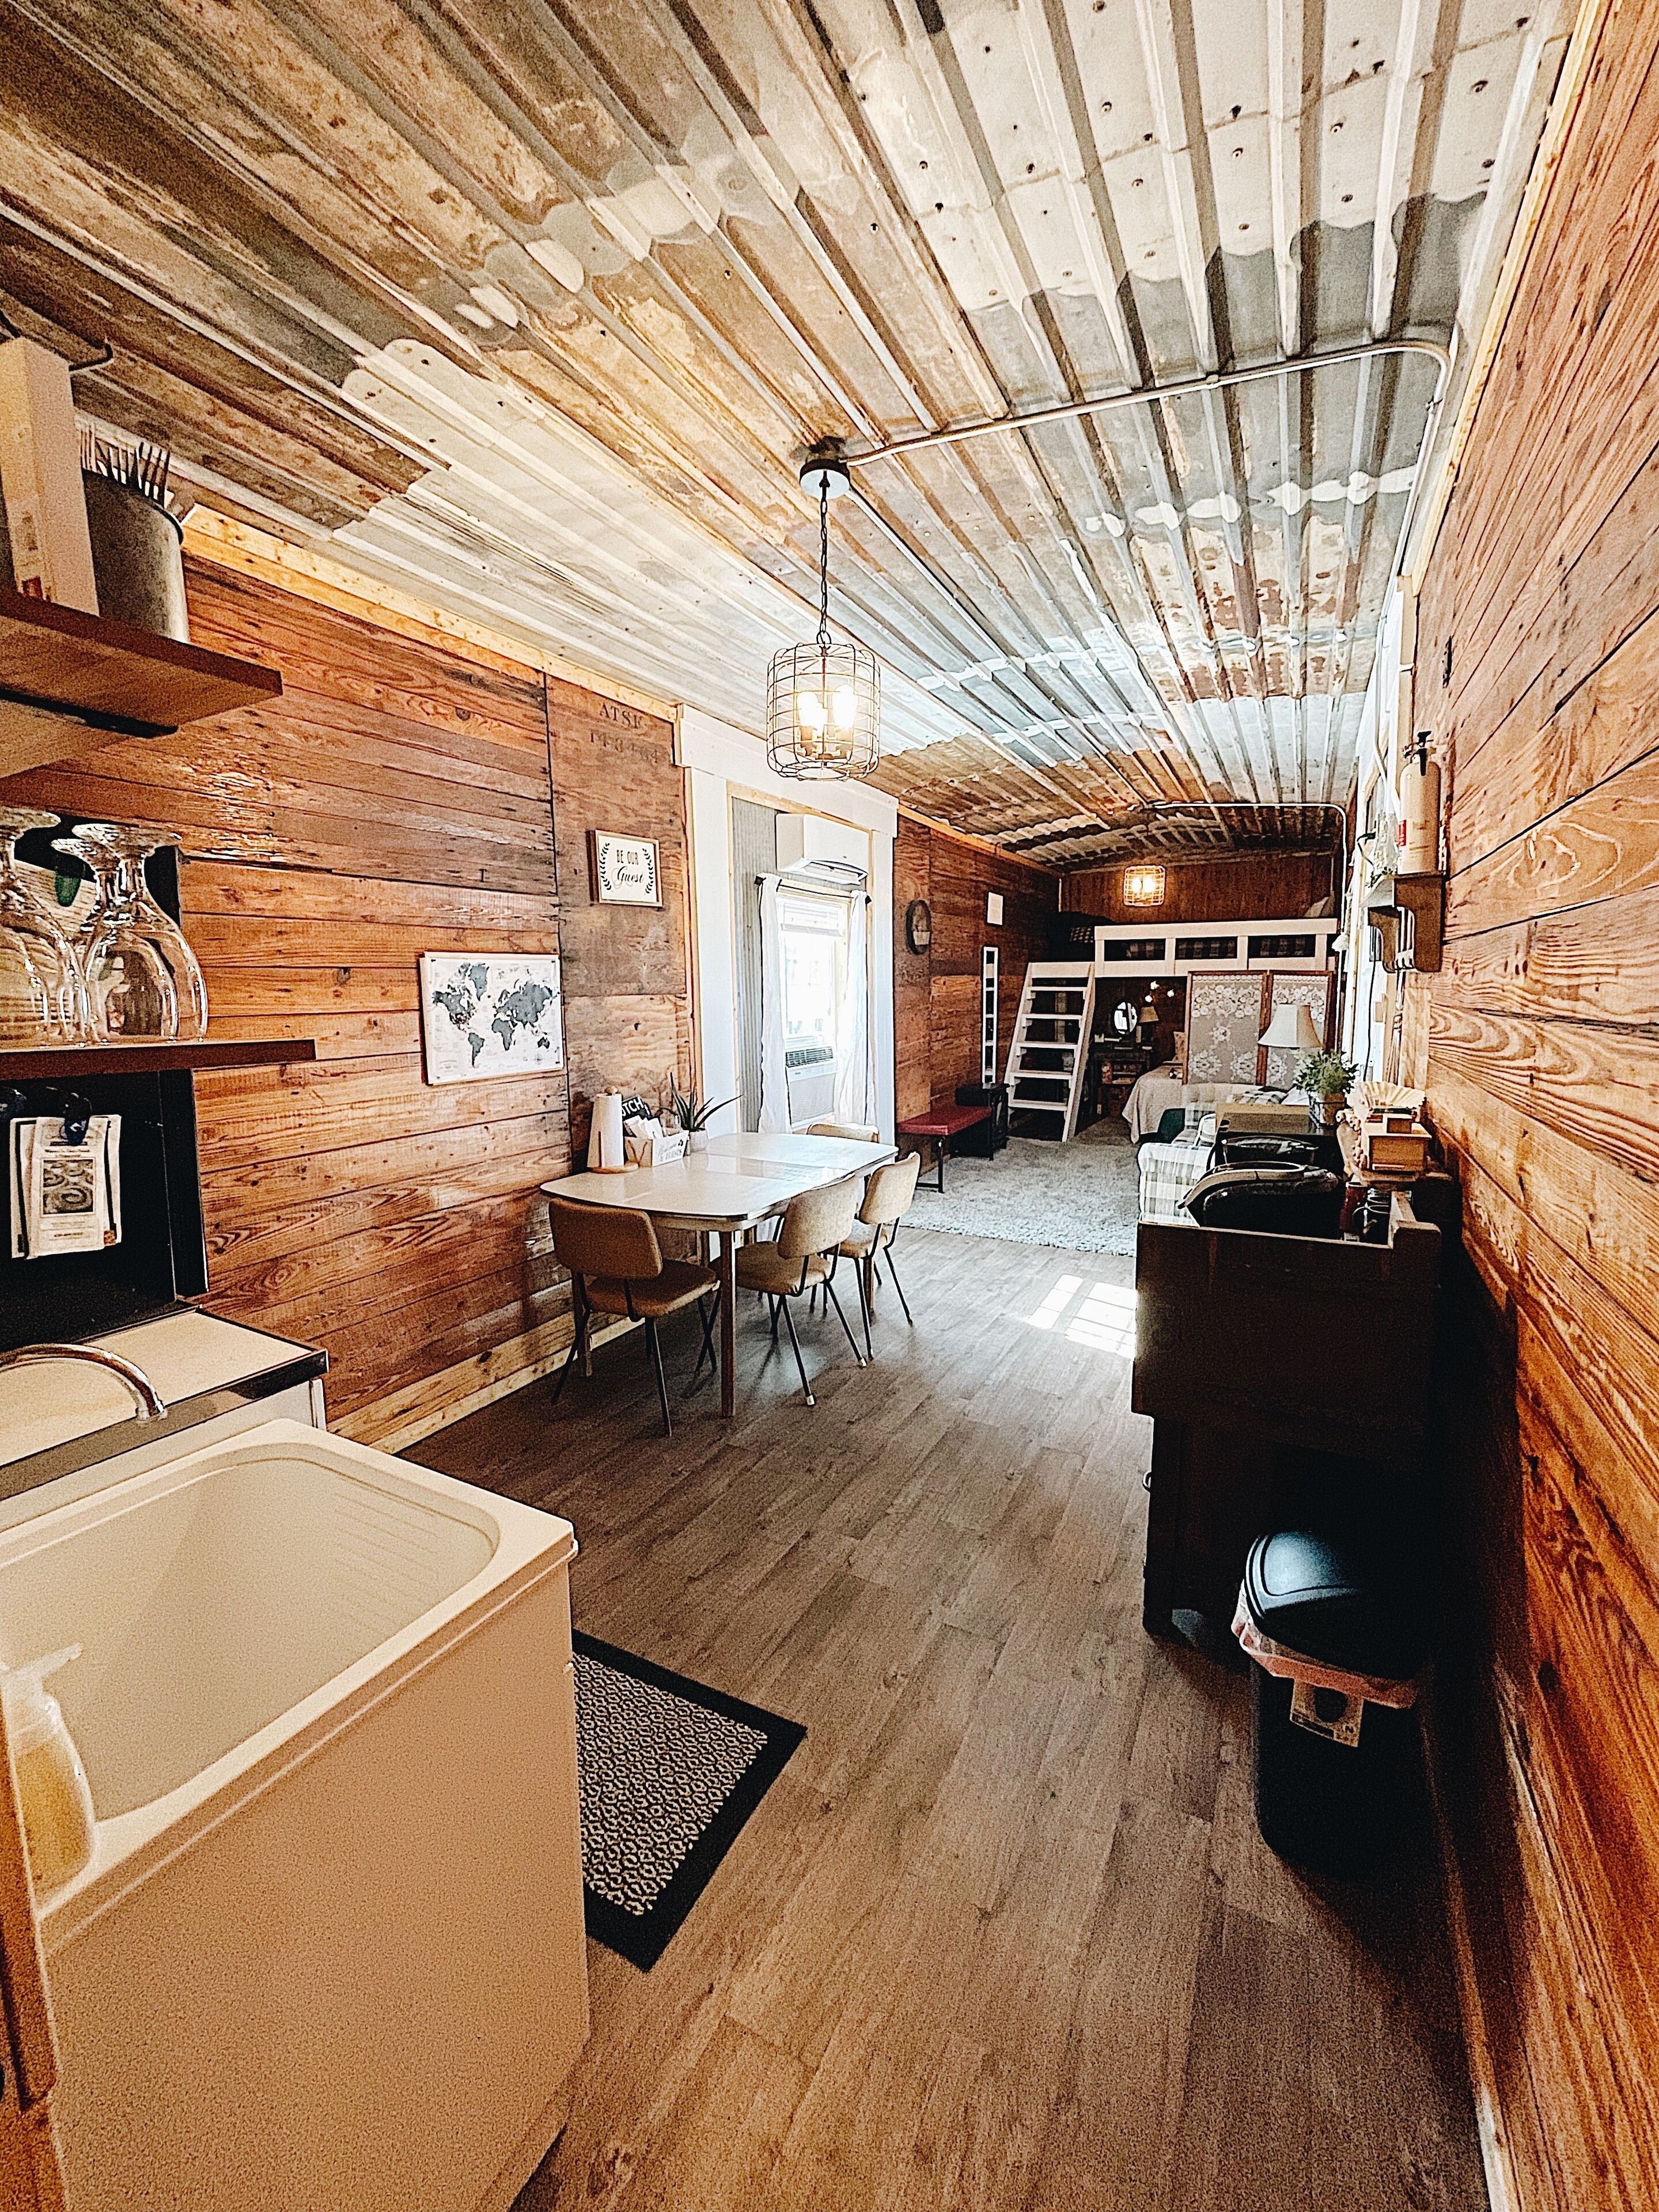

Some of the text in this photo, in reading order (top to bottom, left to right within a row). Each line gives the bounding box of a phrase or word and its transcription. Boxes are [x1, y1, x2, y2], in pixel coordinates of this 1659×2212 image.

[616, 850, 639, 865] BE OUR
[612, 866, 644, 887] Guest
